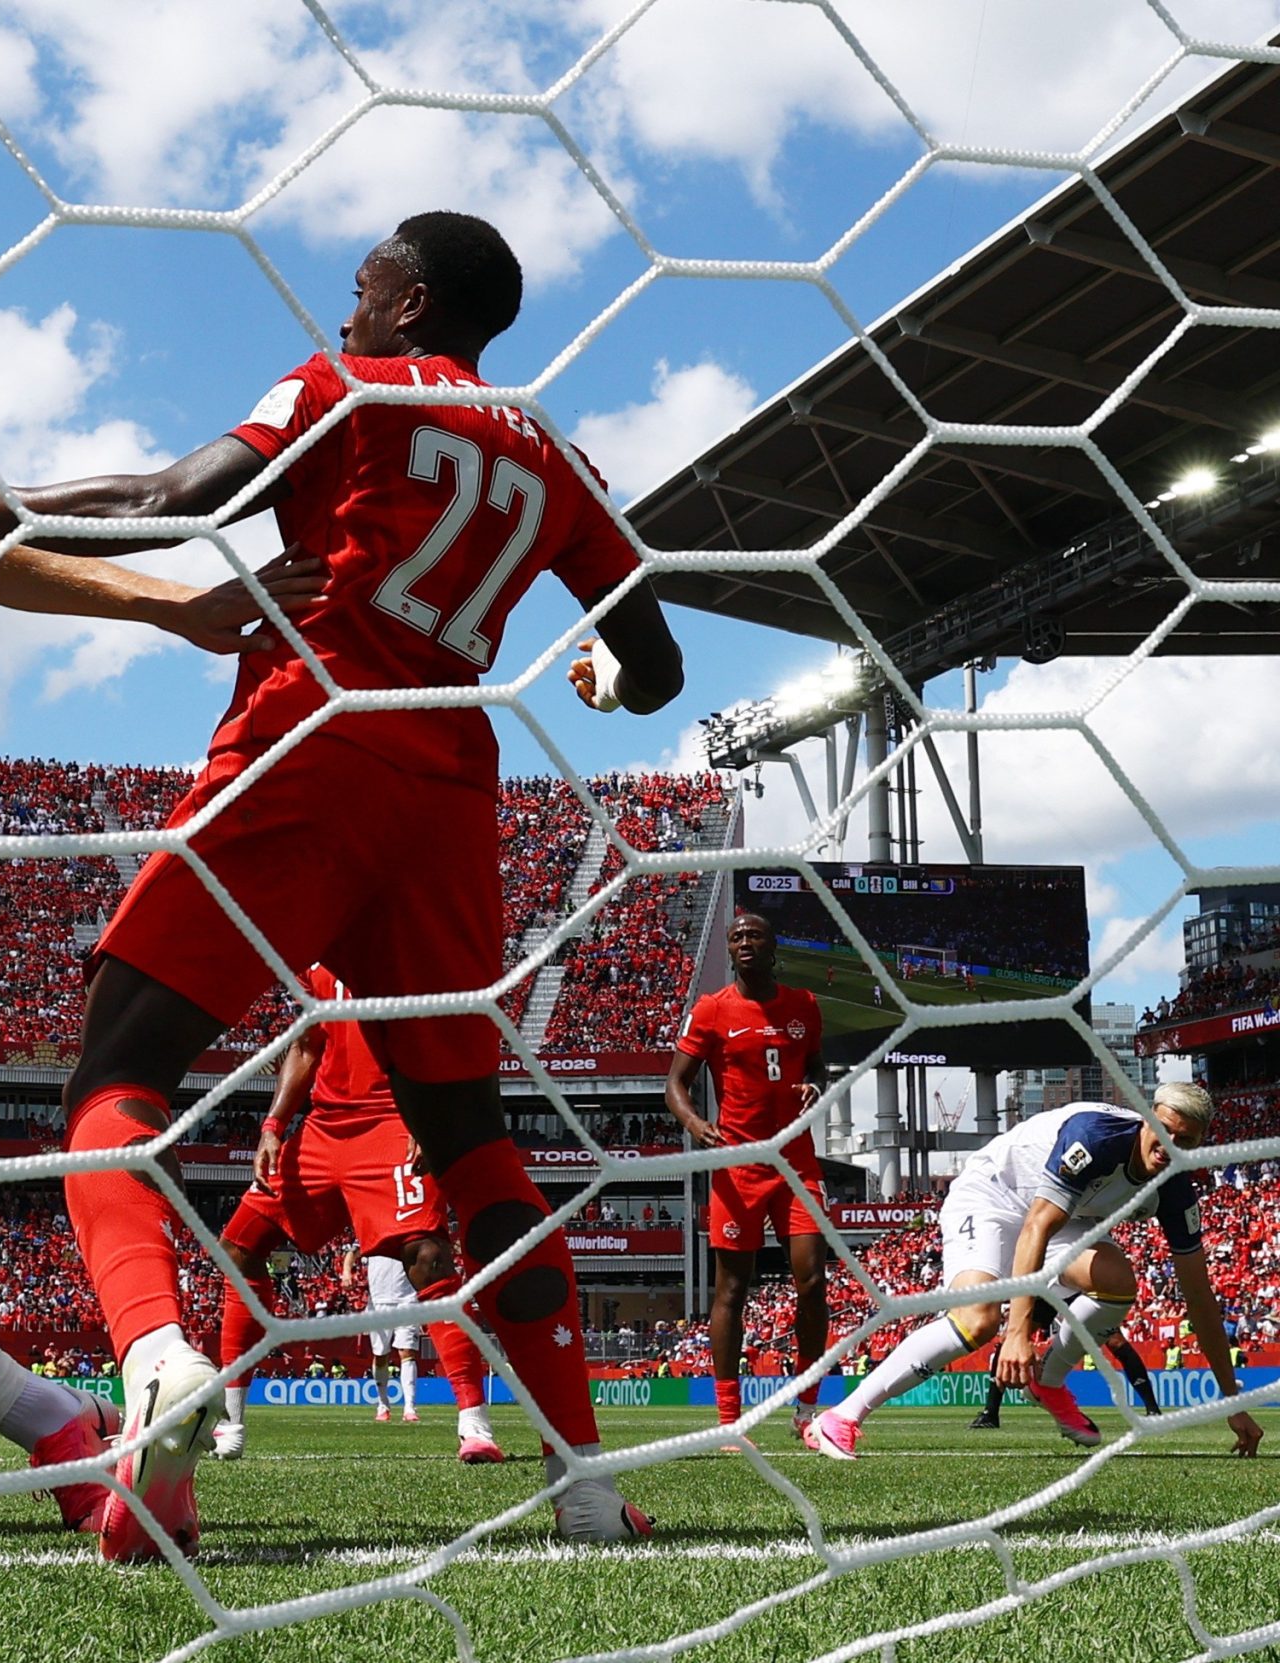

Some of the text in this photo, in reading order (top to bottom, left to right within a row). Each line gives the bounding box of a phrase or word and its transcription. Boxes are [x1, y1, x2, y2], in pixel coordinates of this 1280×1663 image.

[370, 425, 546, 668] 22
[756, 877, 793, 890] 20:25
[832, 879, 851, 889] CAN
[995, 969, 1081, 989] GLOBAL ENERGY PART
[1231, 1015, 1255, 1033] FIFA
[522, 1059, 549, 1071] CP
[550, 1059, 597, 1070] 2026
[765, 1048, 782, 1082] 8
[884, 1051, 947, 1064] Hisense
[393, 1163, 425, 1208] 13
[841, 1209, 934, 1223] FIFA WORD
[958, 1215, 976, 1241] 4
[264, 1379, 404, 1404] aramco
[598, 1379, 651, 1406] aramco
